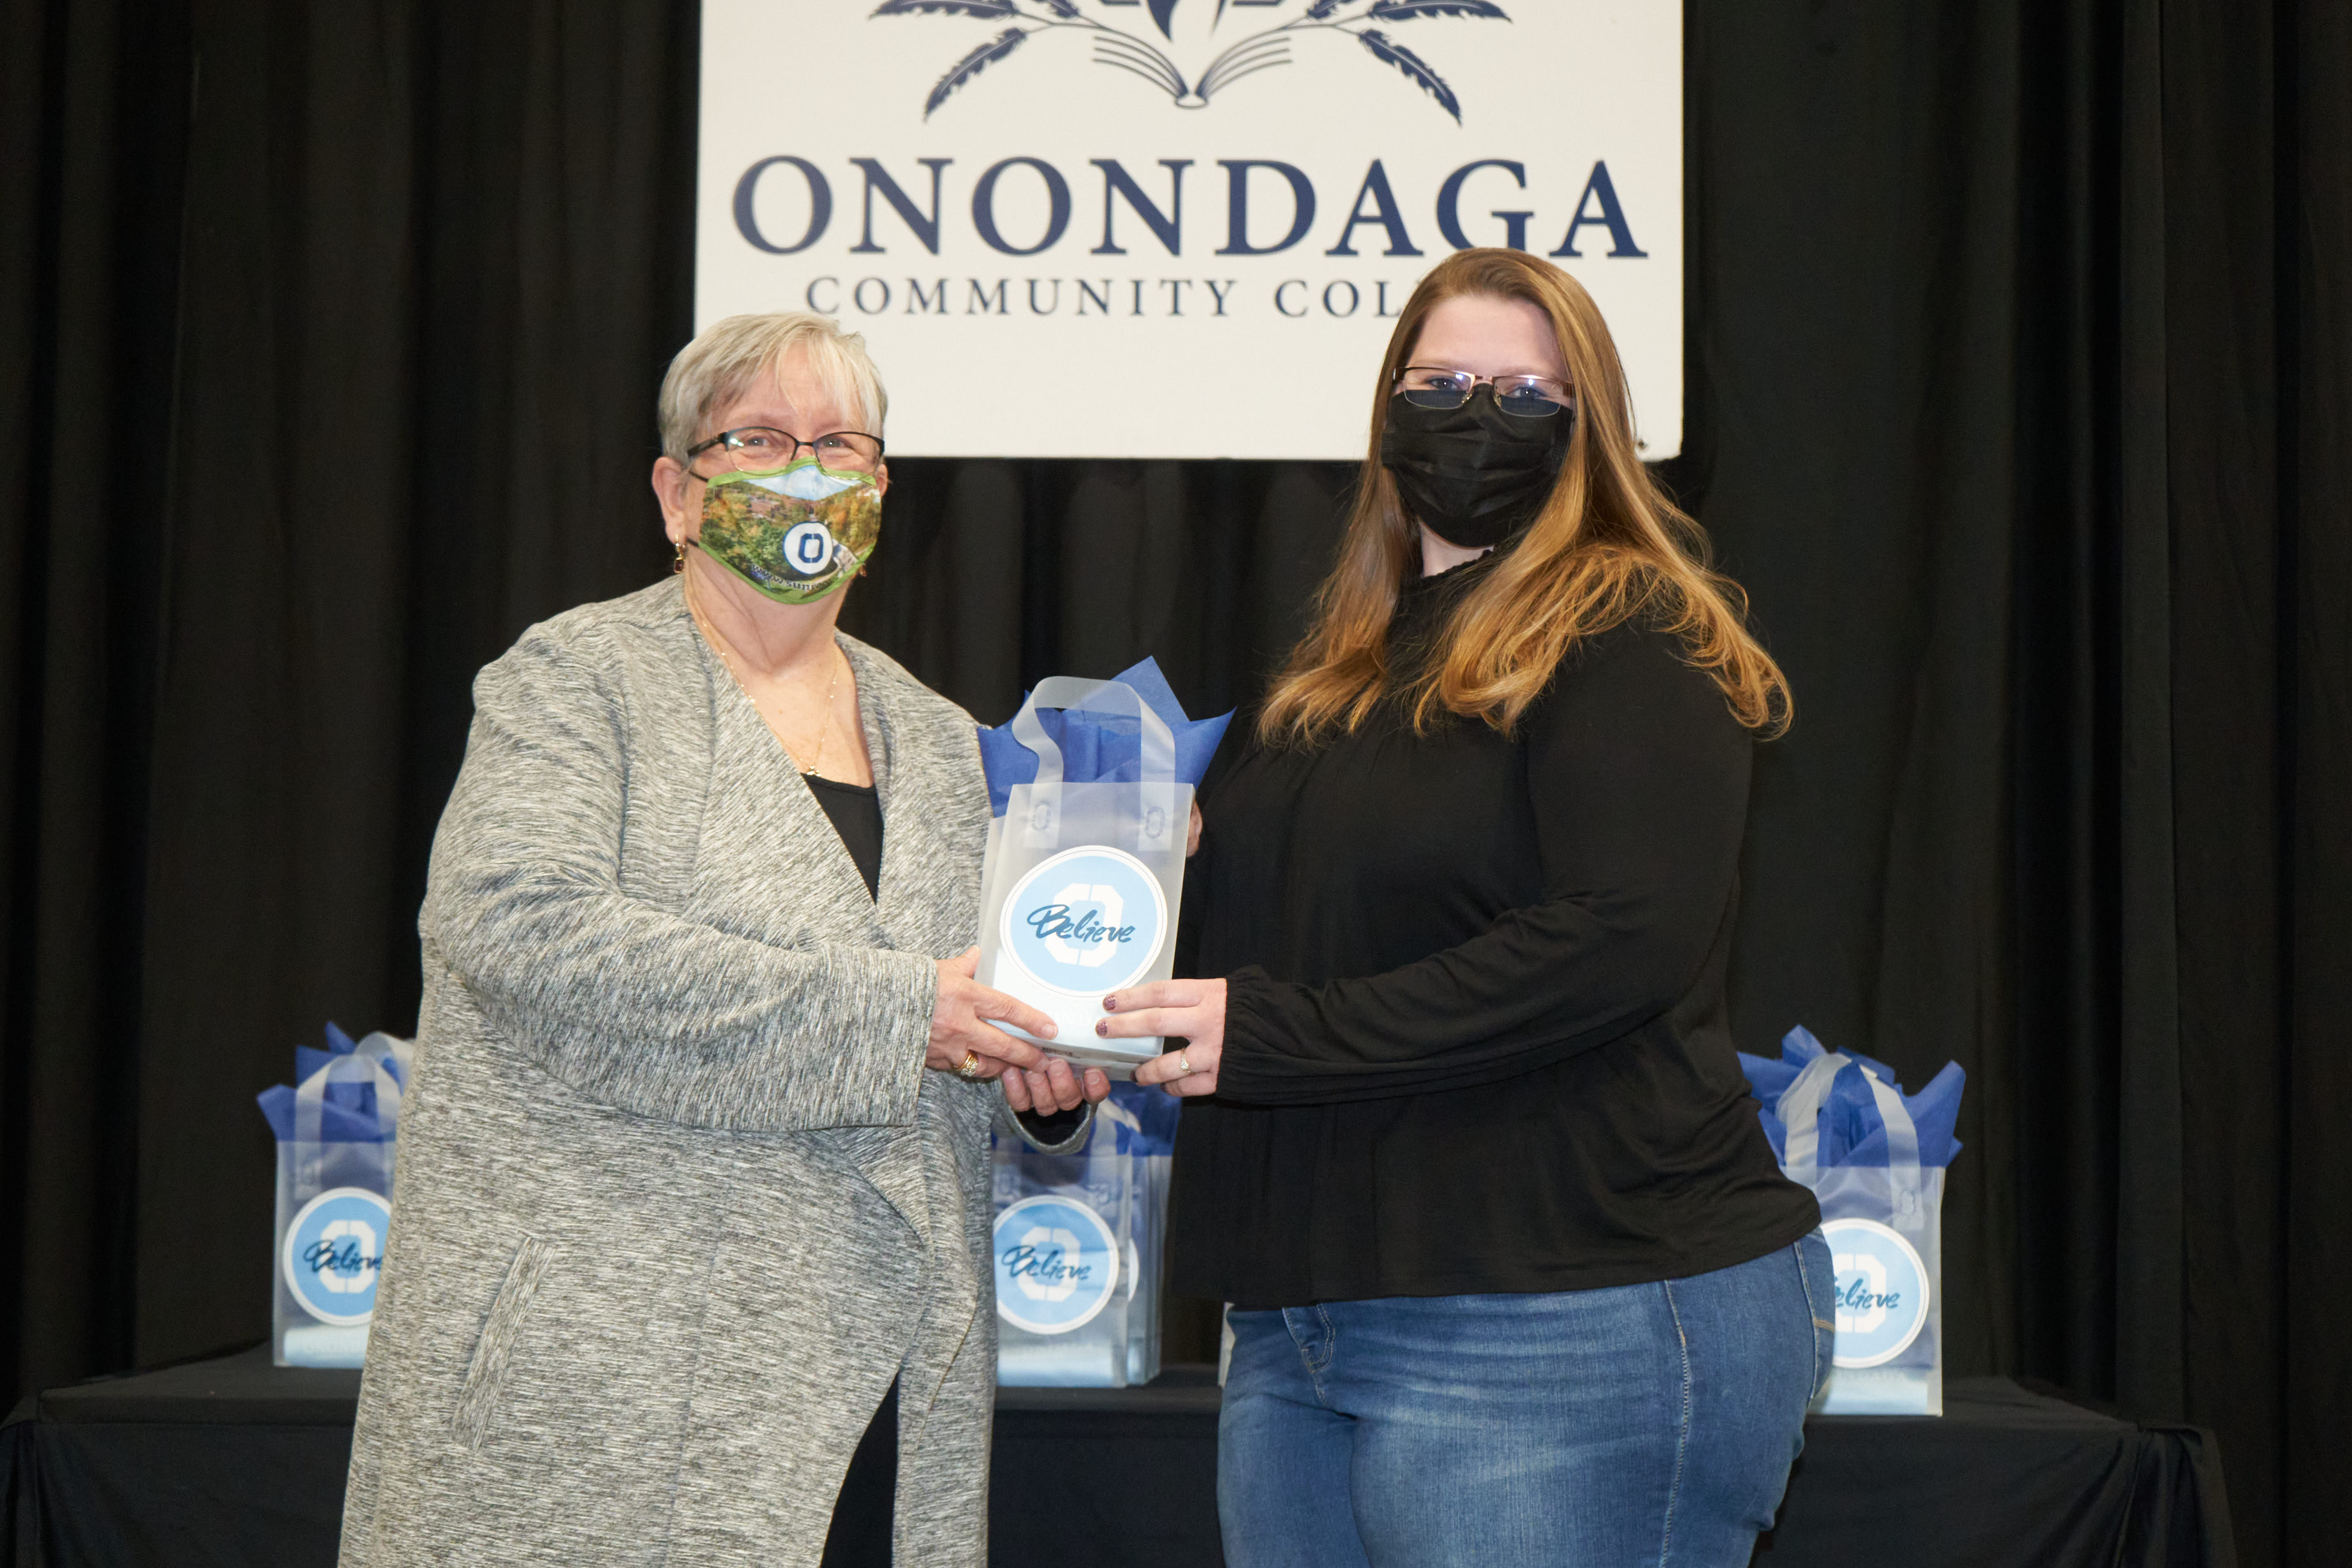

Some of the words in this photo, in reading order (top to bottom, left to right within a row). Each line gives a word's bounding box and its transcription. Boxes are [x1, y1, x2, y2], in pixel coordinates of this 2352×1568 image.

[732, 155, 1648, 258] ONONDAGA
[806, 277, 1237, 317] COMMUNITY
[1275, 279, 1403, 317] COL
[798, 533, 824, 563] O
[1026, 904, 1136, 944] Believe
[1002, 1245, 1091, 1279] Believe
[1834, 1276, 1901, 1310] elieve
